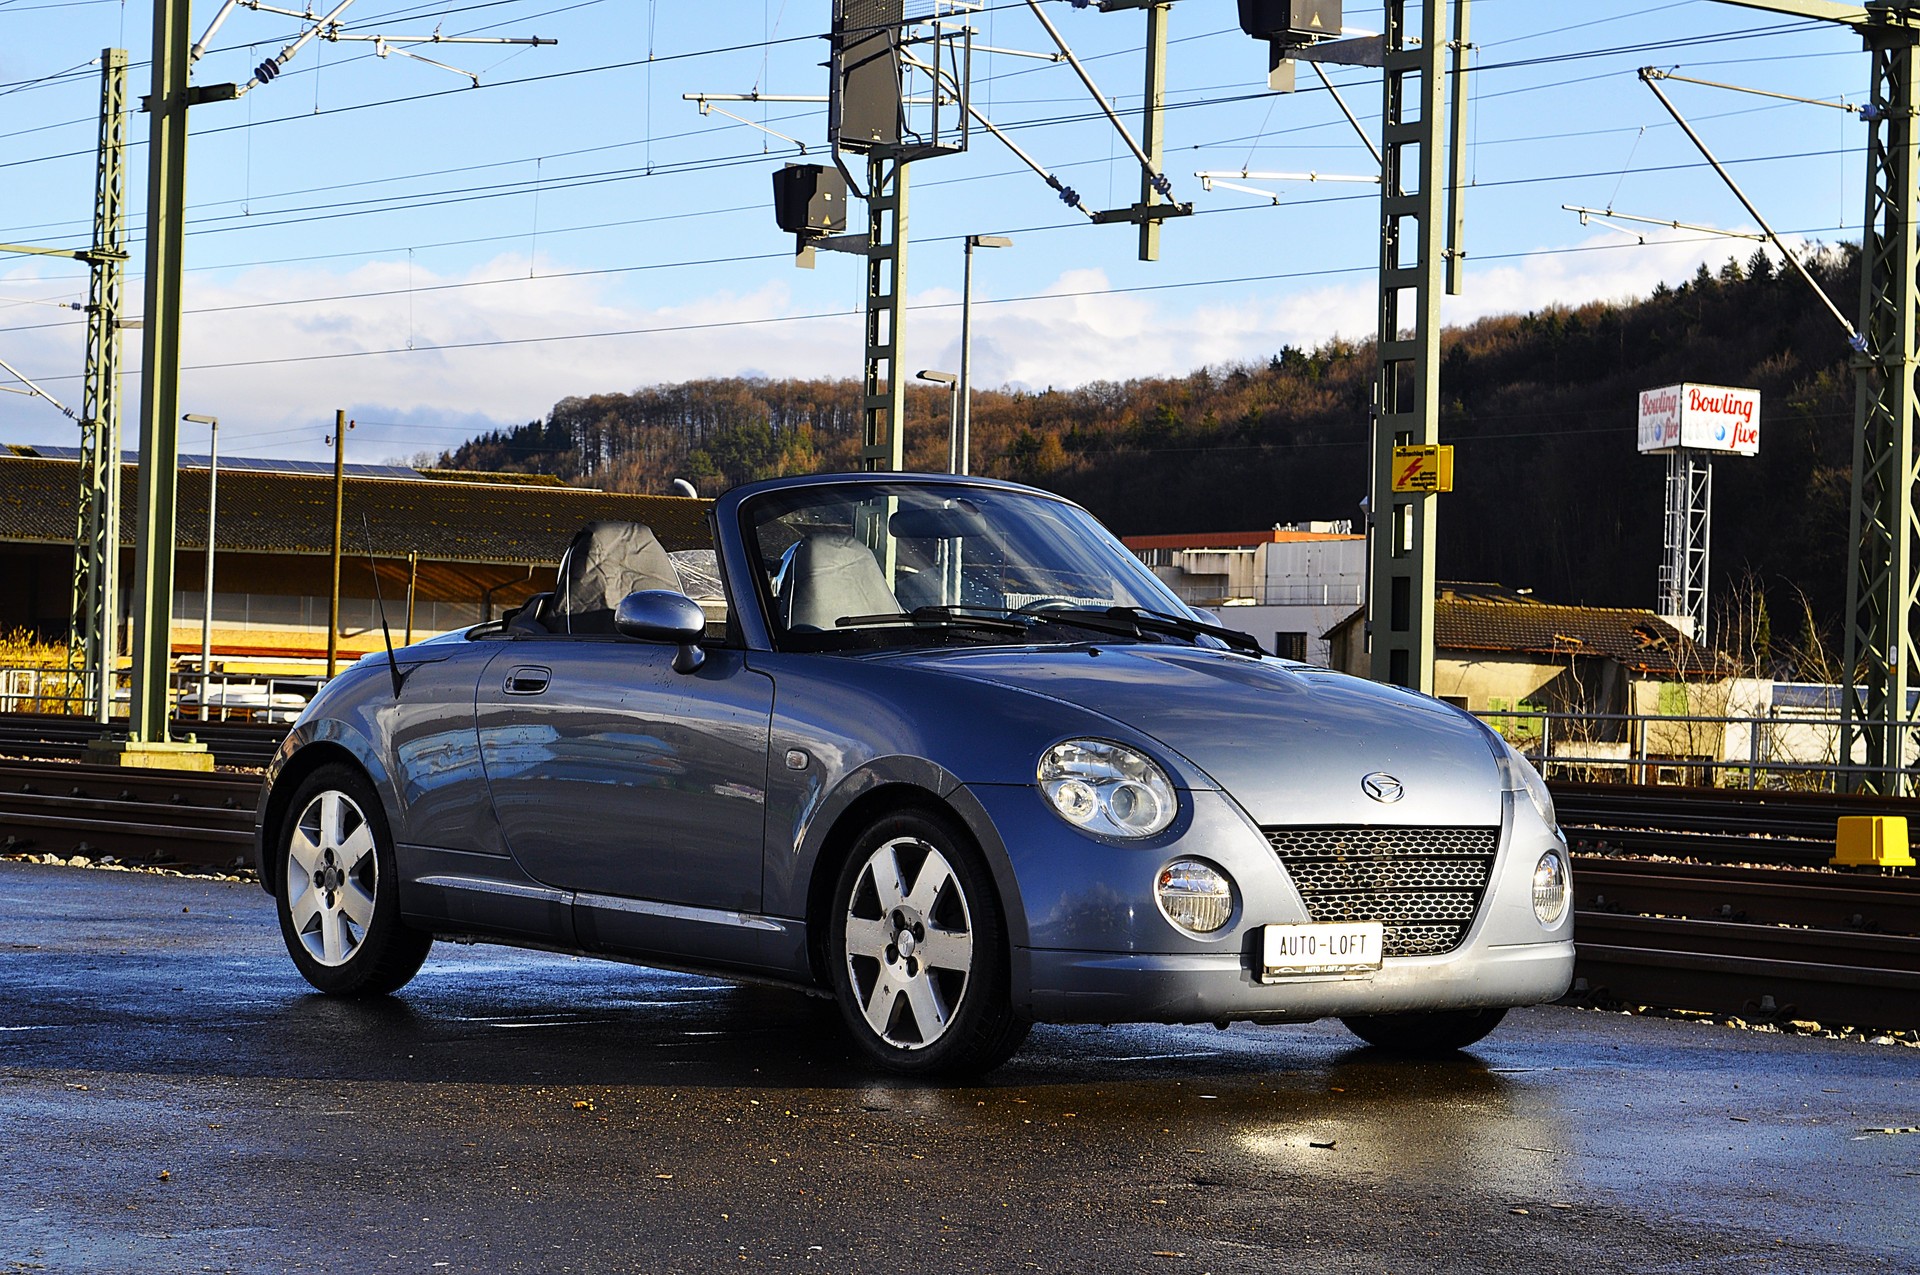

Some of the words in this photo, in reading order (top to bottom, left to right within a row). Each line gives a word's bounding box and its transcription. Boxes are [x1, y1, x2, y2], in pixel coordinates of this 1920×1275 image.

[1642, 391, 1677, 418] Bowling
[1689, 388, 1753, 423] Bowling
[1664, 417, 1679, 446] five
[1729, 421, 1758, 448] five
[1280, 934, 1367, 956] AUTO-LOFT
